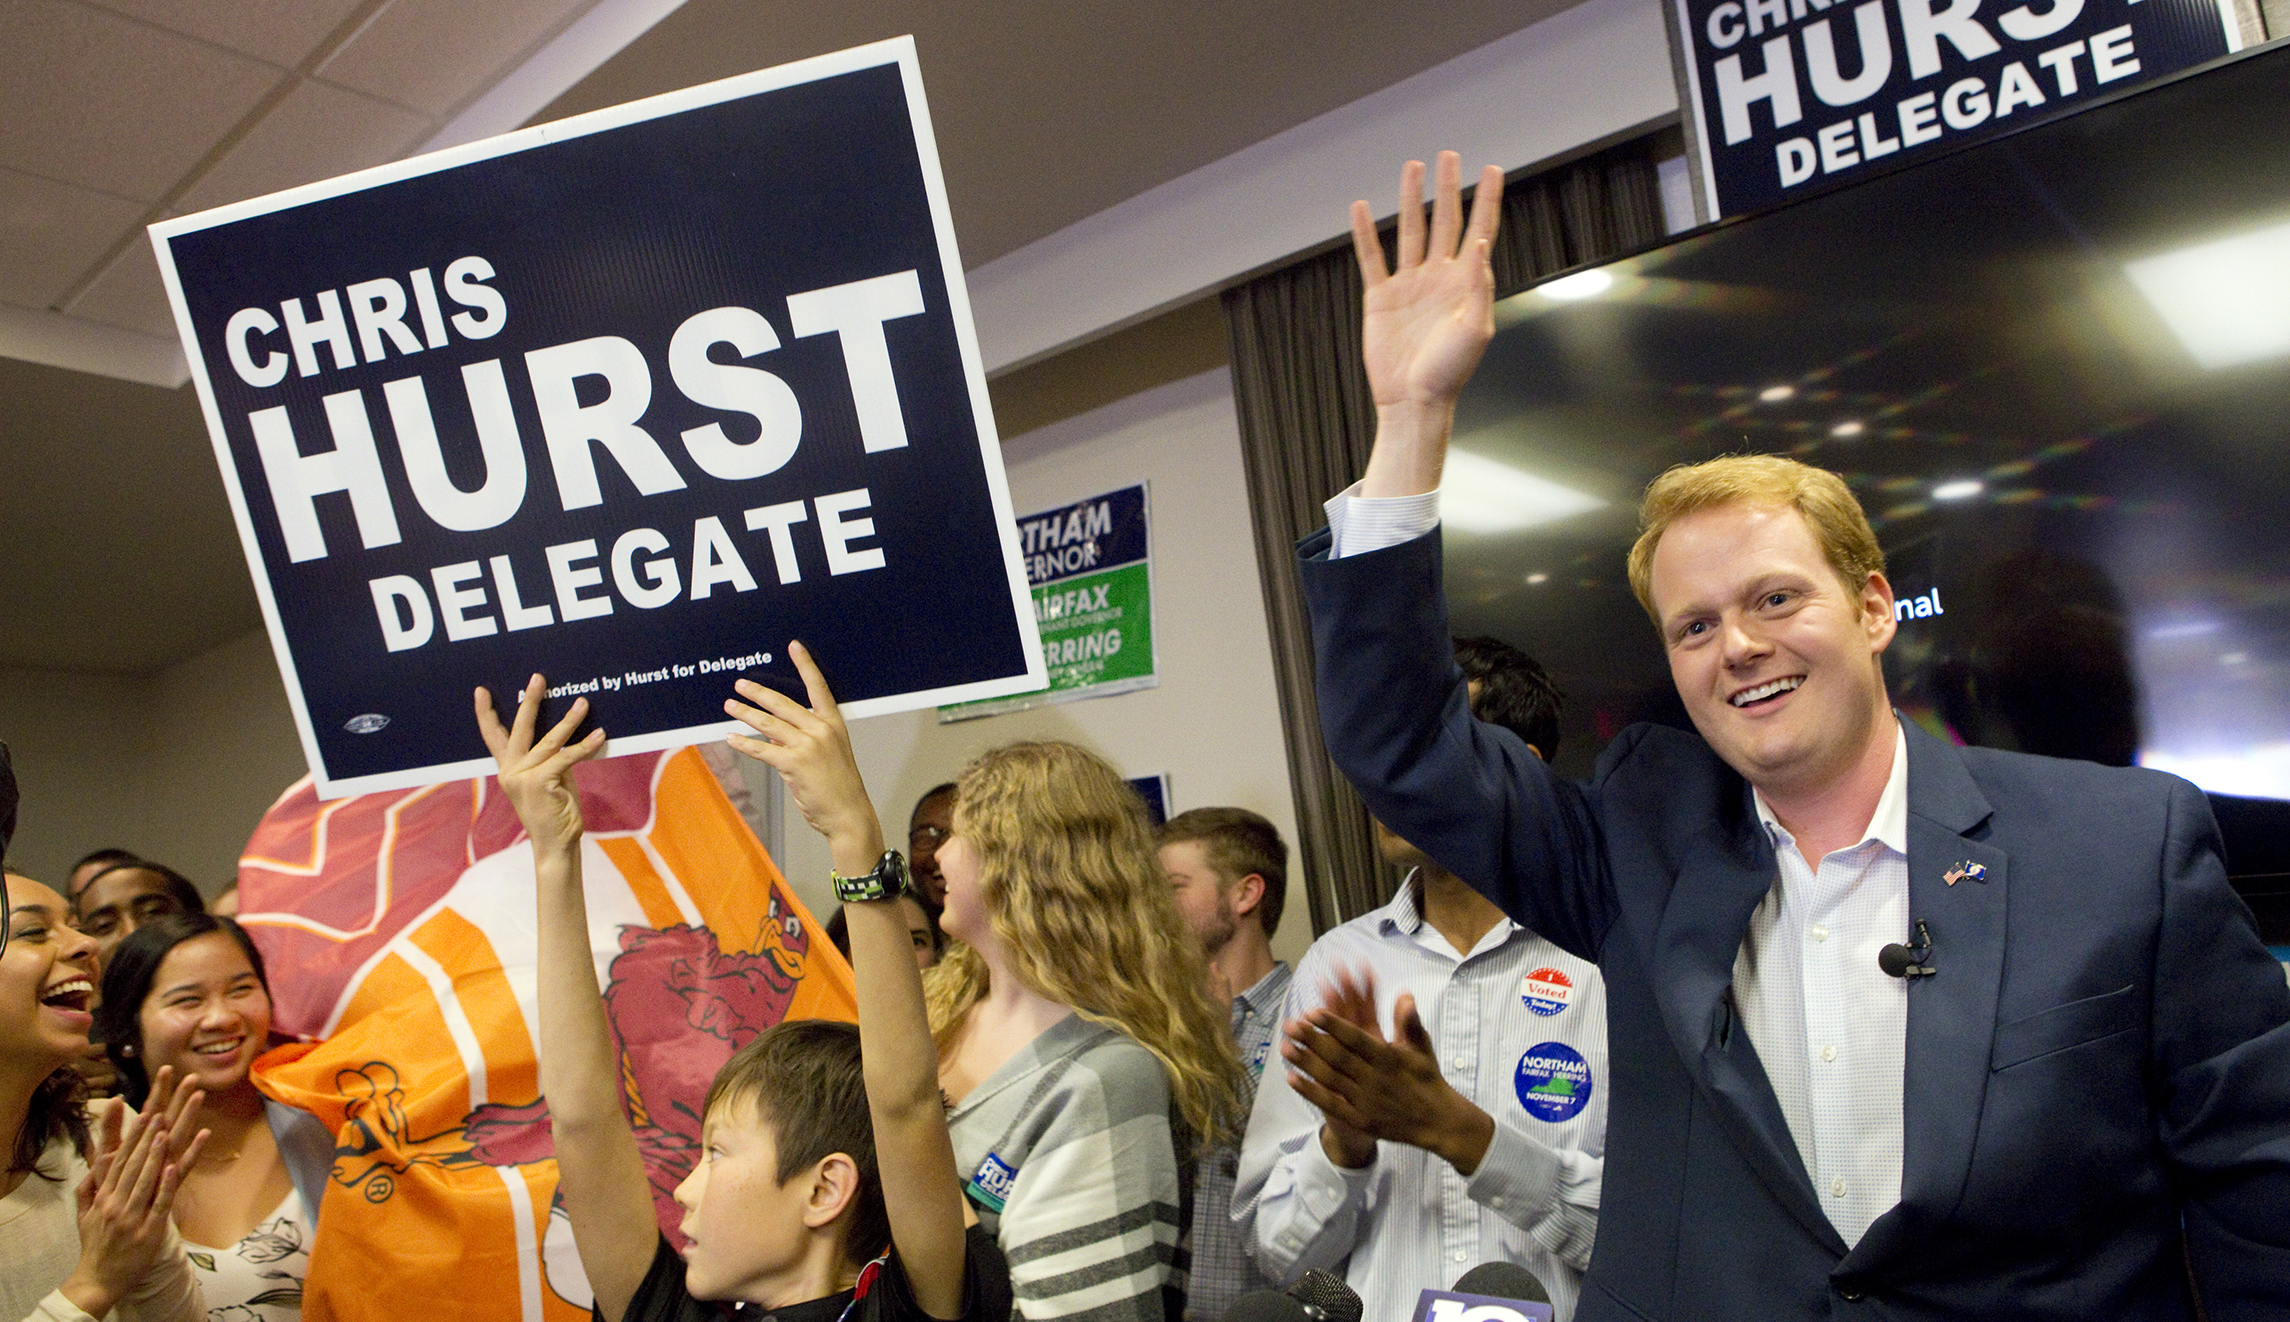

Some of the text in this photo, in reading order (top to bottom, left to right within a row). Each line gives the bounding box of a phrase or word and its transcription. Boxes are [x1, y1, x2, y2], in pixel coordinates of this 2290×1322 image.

[1774, 23, 2142, 189] DELEGATE
[225, 255, 508, 389] CHRIS
[247, 268, 927, 564] HURST
[1018, 500, 1112, 555] THAM
[368, 487, 887, 653] DELEGATE
[601, 675, 622, 692] by
[624, 665, 670, 686] Hurst
[671, 663, 696, 679] for
[698, 650, 773, 674] Delegate
[1042, 628, 1121, 668] RRING
[1528, 982, 1567, 999] Voted
[1522, 1055, 1587, 1074] NORTHAM
[1526, 1092, 1577, 1105] NOVEMBER 7
